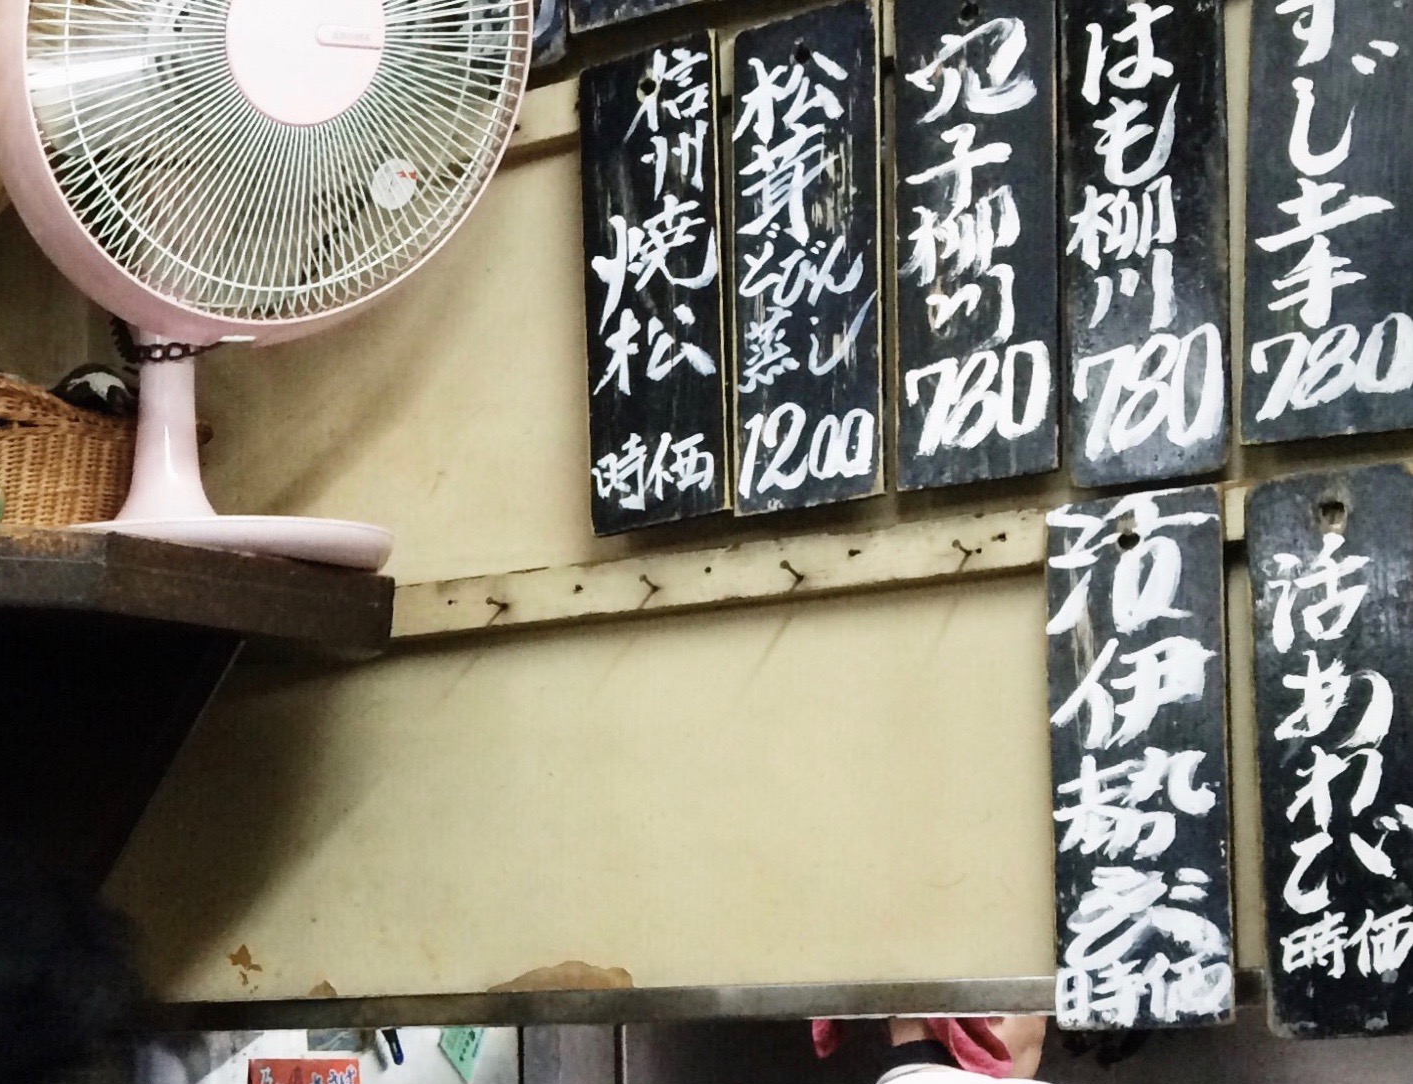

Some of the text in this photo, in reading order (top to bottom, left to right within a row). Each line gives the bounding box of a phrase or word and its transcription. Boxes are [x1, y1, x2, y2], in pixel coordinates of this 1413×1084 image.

[1066, 3, 1226, 461] はも柳川 780
[905, 340, 1050, 456] 780
[1250, 312, 1413, 422] 780
[592, 433, 714, 510] 時価
[737, 402, 874, 499] 1200
[1055, 951, 1232, 1027] 時価
[1281, 904, 1413, 978] 時価
